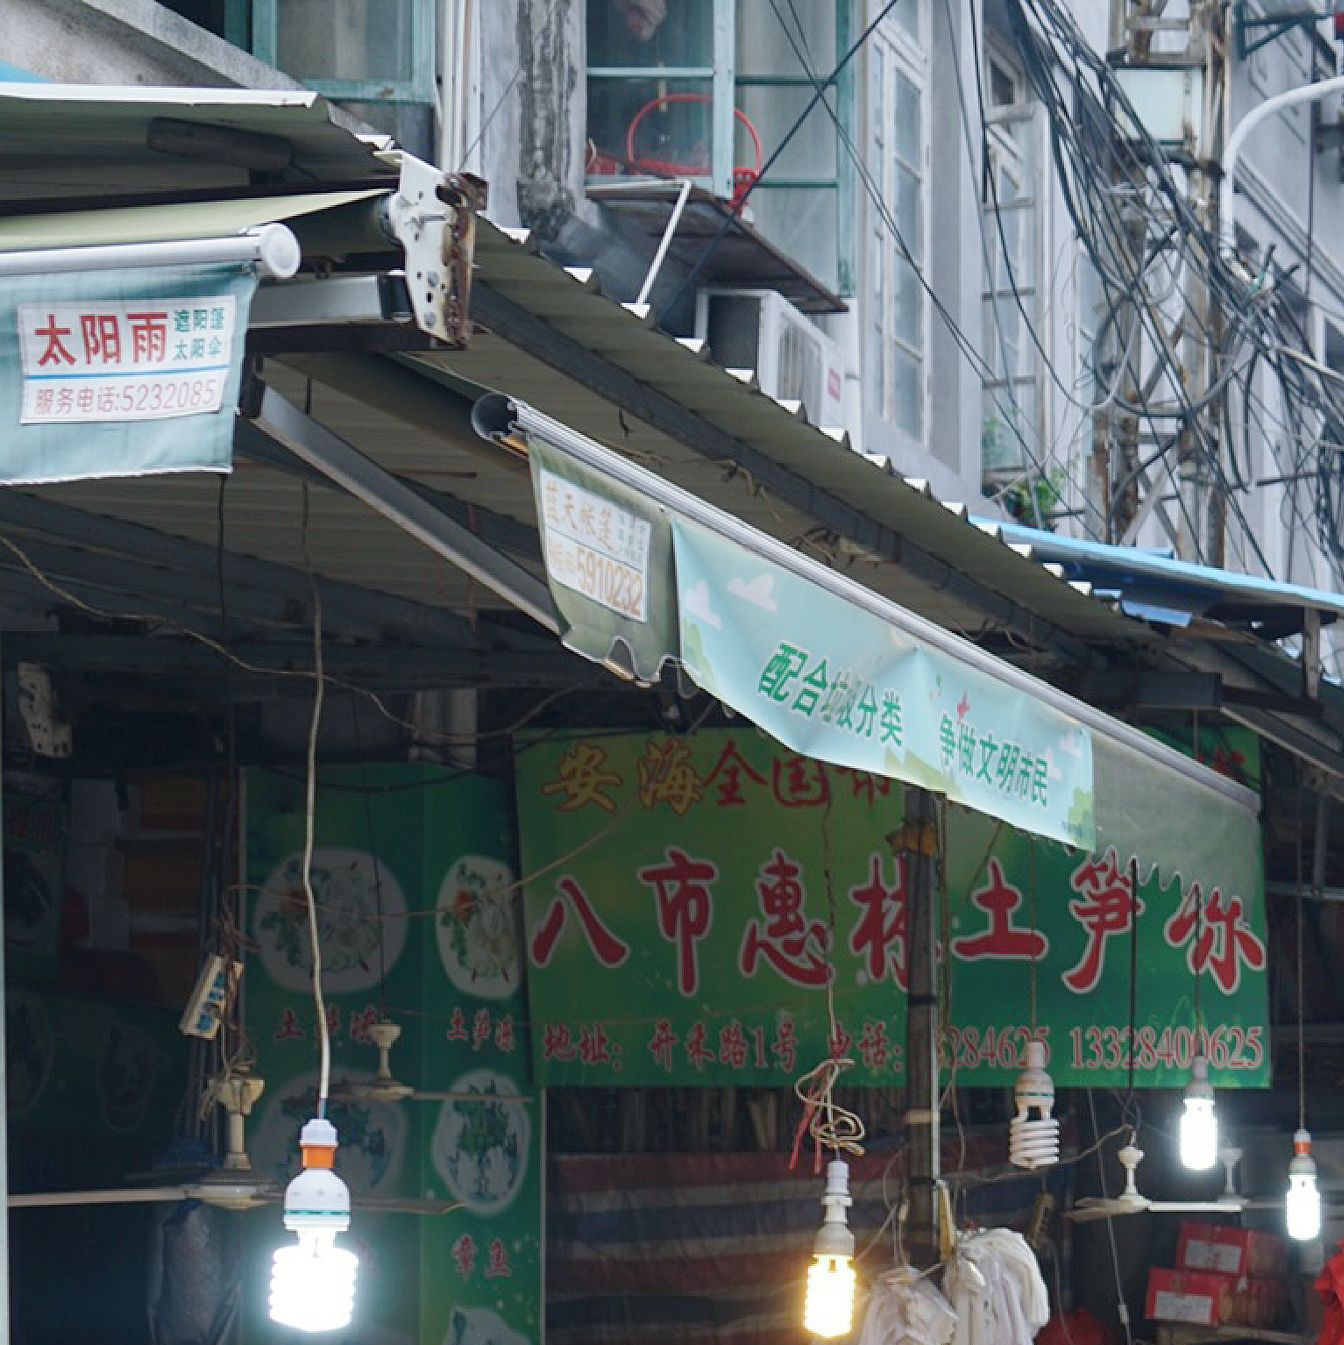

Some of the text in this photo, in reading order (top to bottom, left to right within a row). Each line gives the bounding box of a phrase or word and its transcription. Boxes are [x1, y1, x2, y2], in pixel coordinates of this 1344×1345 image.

[33, 311, 168, 367] 太阳雨
[174, 336, 222, 361] 太阳伞
[759, 643, 1047, 807] 配合垃圾分类 争做文明市民
